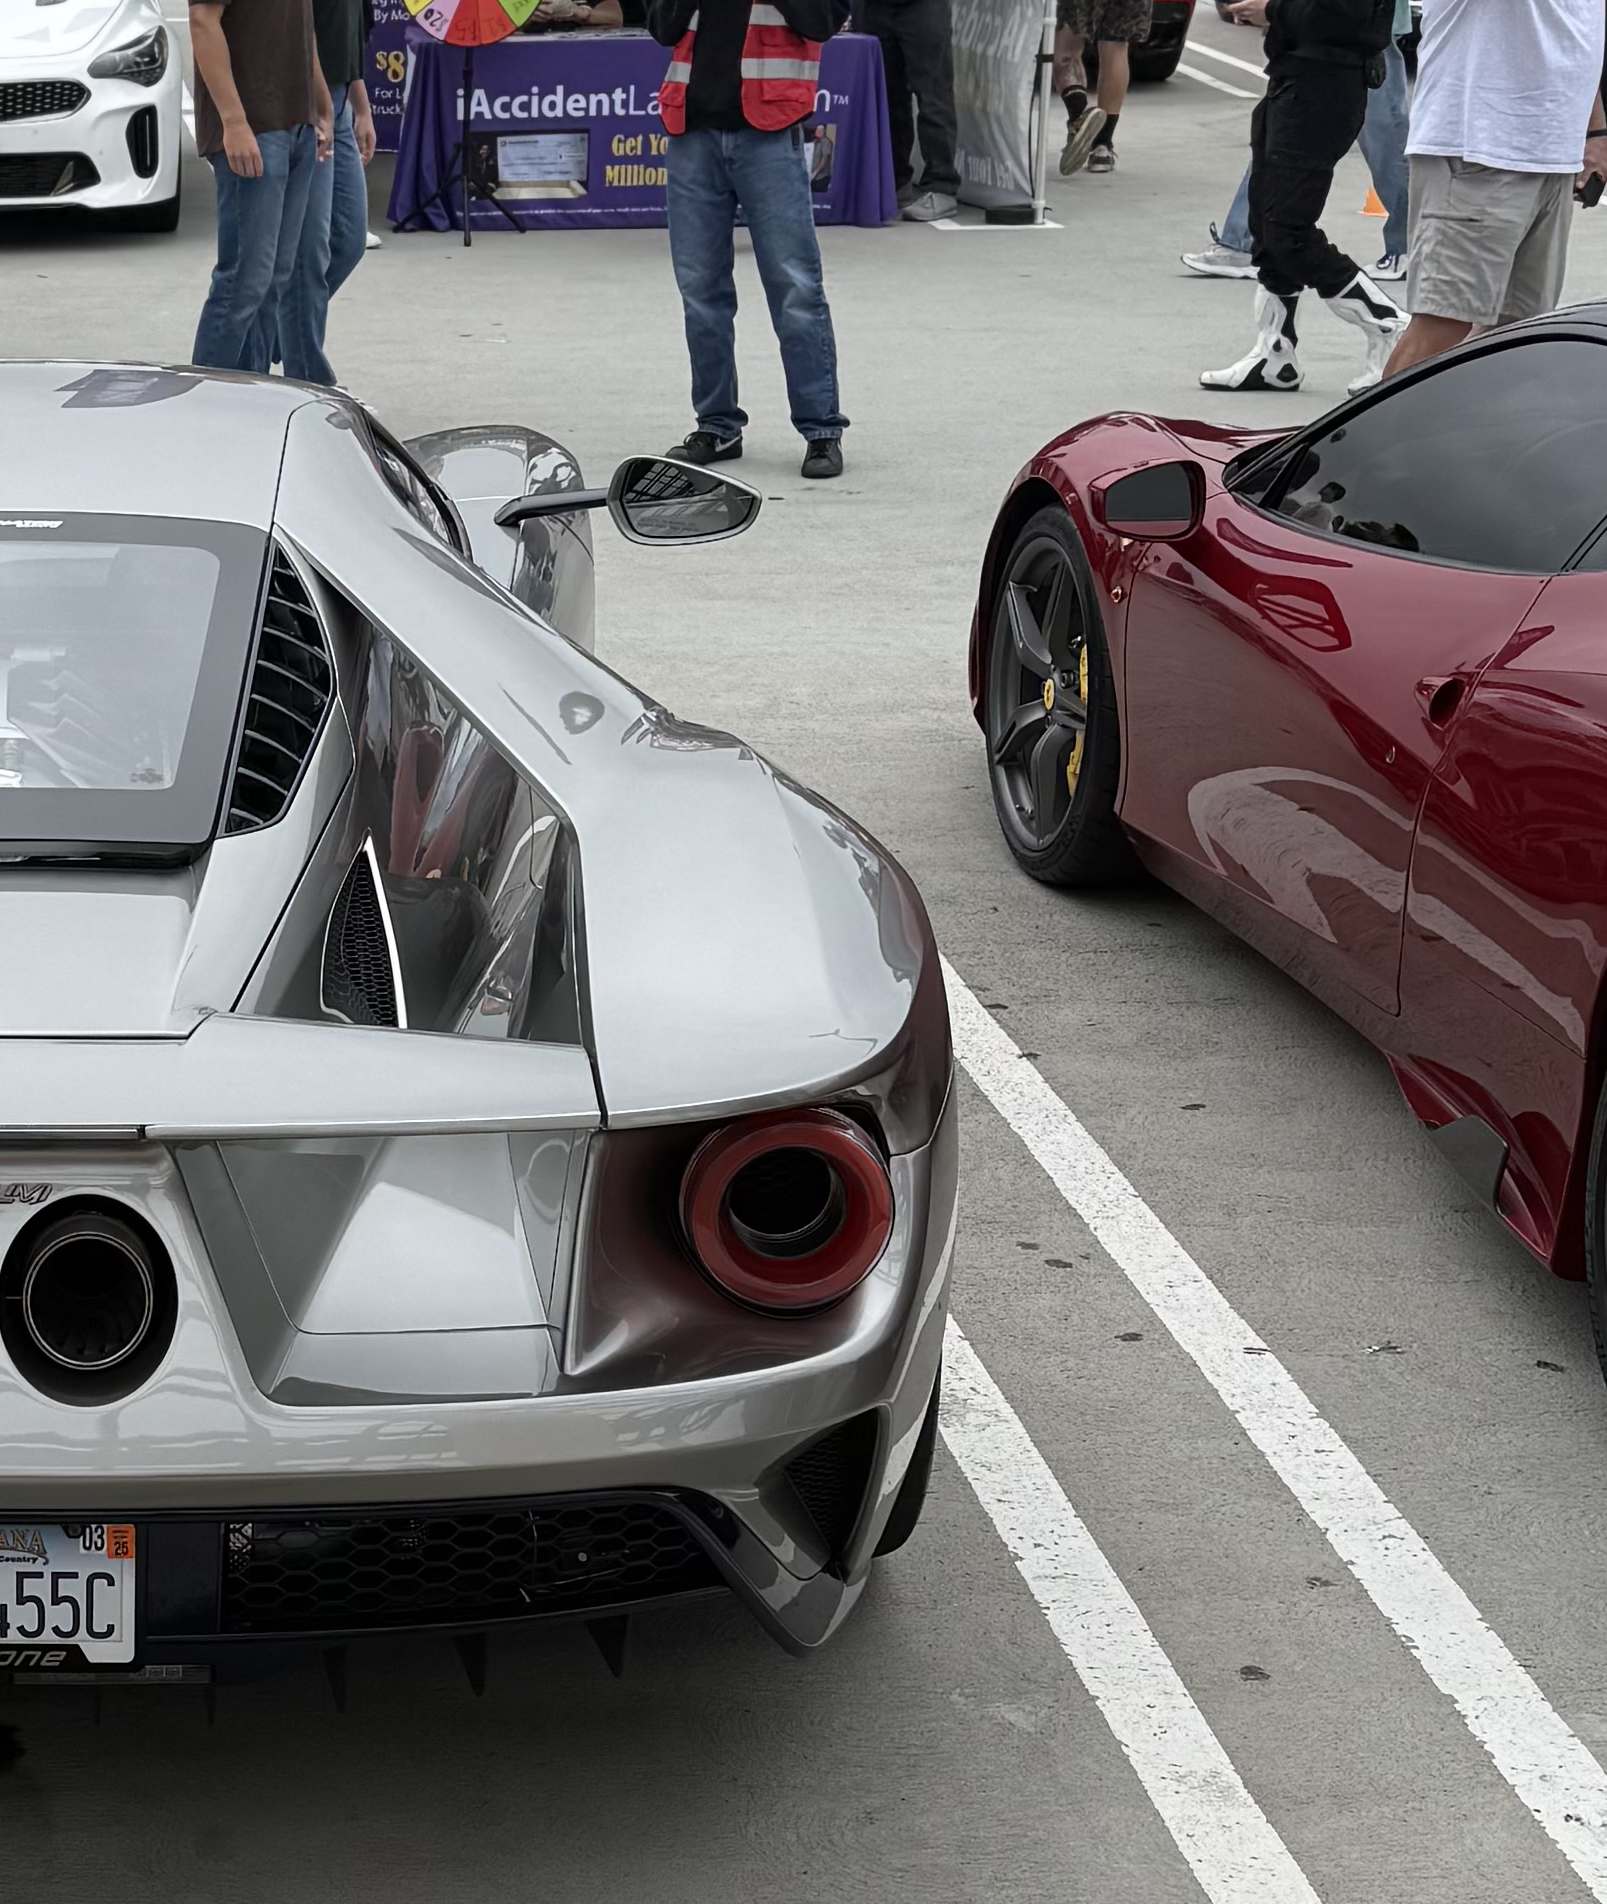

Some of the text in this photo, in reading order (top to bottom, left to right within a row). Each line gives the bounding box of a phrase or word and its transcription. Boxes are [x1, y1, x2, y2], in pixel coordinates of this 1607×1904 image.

[423, 6, 450, 31] $20
[375, 86, 394, 99] For
[610, 133, 643, 157] Get
[82, 1525, 106, 1552] 03
[113, 1540, 129, 1557] 25
